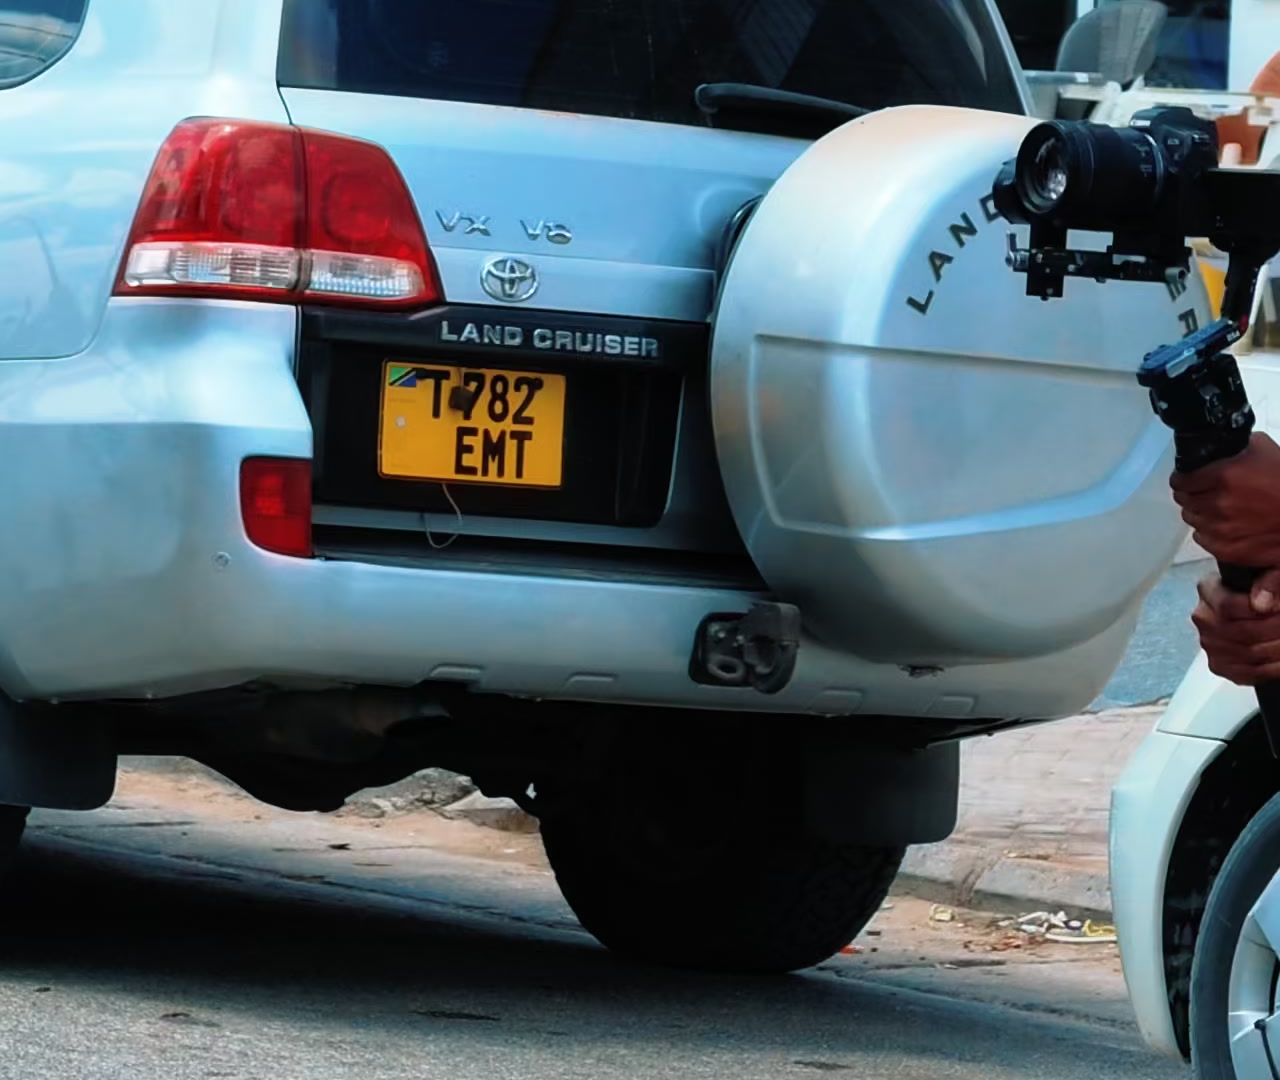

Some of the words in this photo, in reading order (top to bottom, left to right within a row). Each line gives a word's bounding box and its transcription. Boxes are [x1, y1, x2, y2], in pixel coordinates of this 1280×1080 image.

[435, 209, 492, 236] VX
[520, 219, 572, 245] V8
[440, 320, 524, 346] LAND
[533, 328, 659, 358] CRUISER
[419, 369, 451, 419] T
[462, 373, 536, 426] 782
[454, 426, 533, 479] EMT
